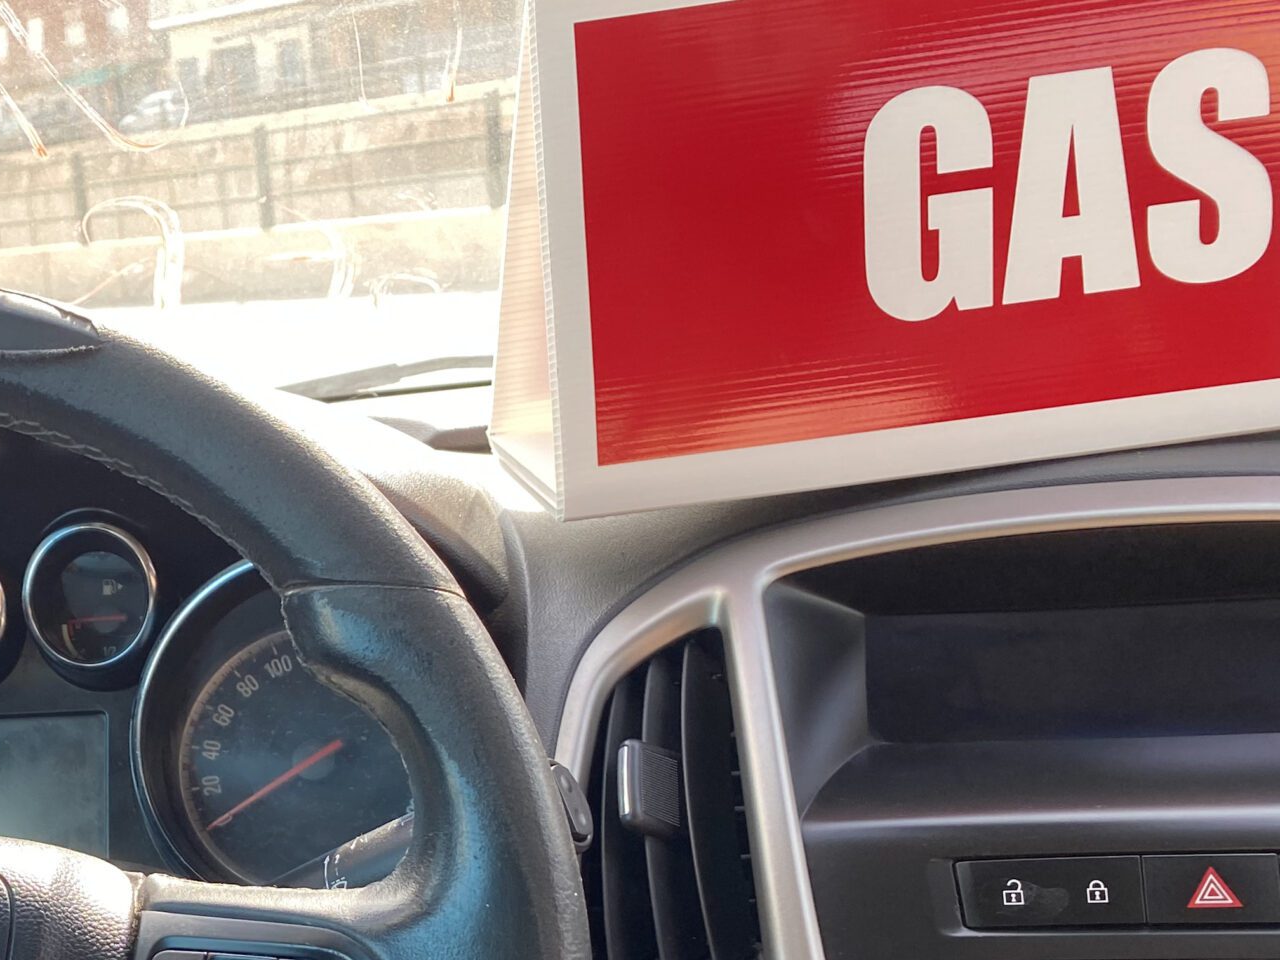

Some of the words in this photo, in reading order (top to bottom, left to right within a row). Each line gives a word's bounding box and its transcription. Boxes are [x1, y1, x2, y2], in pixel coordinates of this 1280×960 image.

[863, 47, 1273, 321] GAS
[264, 655, 293, 679] 100
[235, 674, 260, 698] 80
[212, 703, 235, 727] 60
[201, 739, 221, 761] 40
[201, 774, 222, 797] 20
